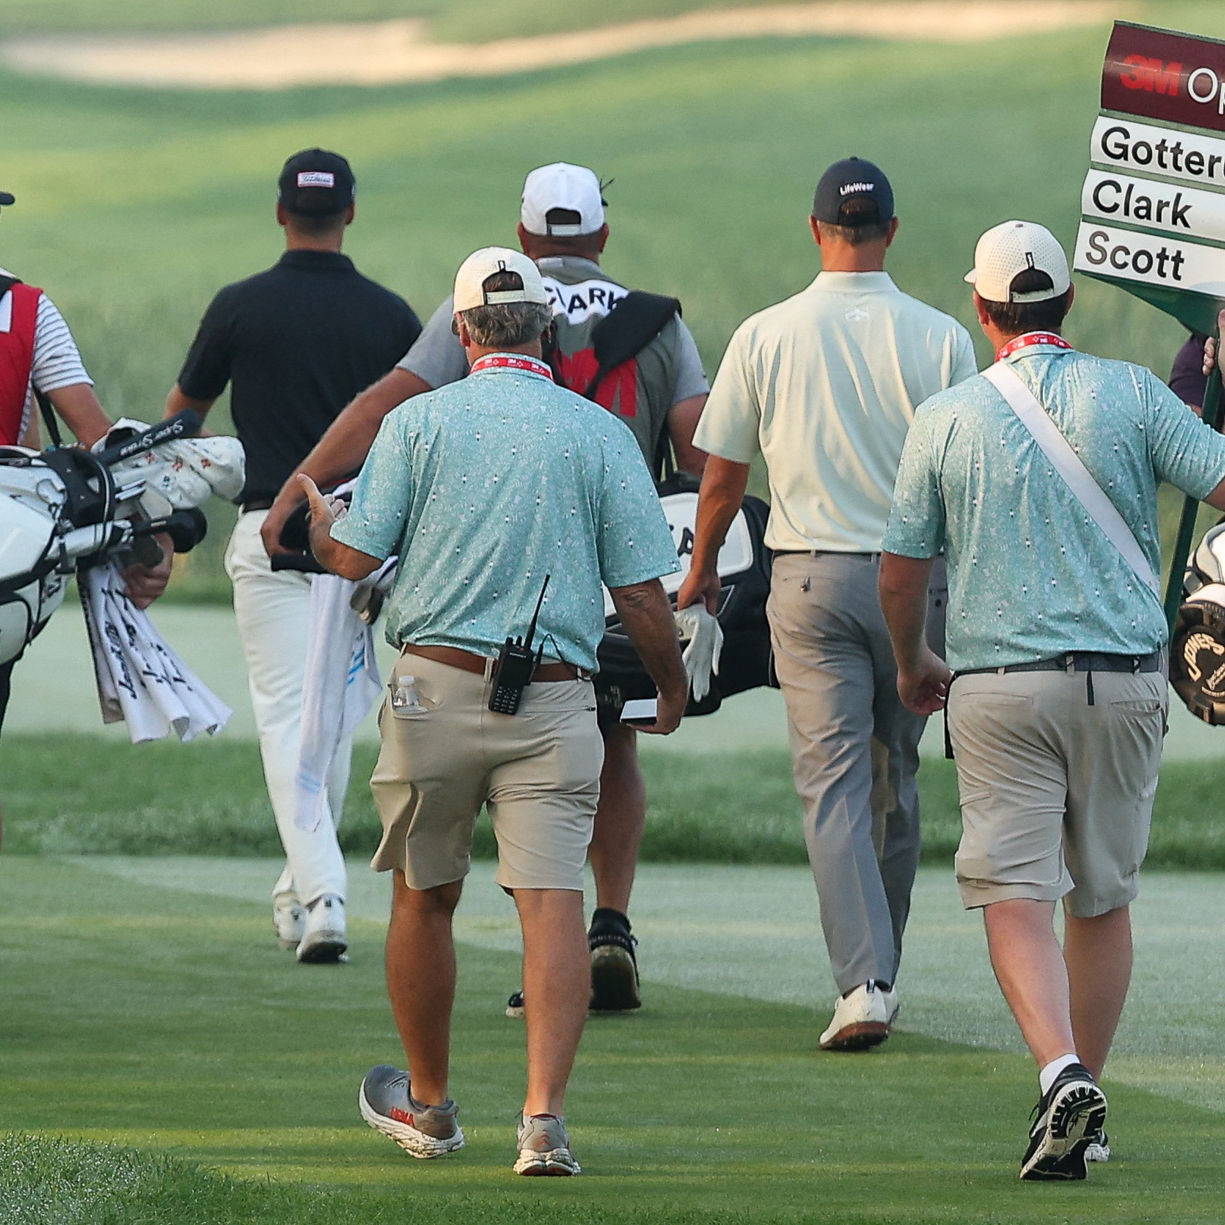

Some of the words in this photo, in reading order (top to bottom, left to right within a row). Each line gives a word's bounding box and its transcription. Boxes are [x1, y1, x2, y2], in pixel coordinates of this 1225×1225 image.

[1119, 54, 1183, 96] 3M
[1101, 126, 1225, 177] Gotter
[839, 182, 875, 196] LifeWear
[1092, 179, 1192, 229] Clark
[1085, 230, 1185, 281] Scott
[1183, 632, 1225, 682] JONES
